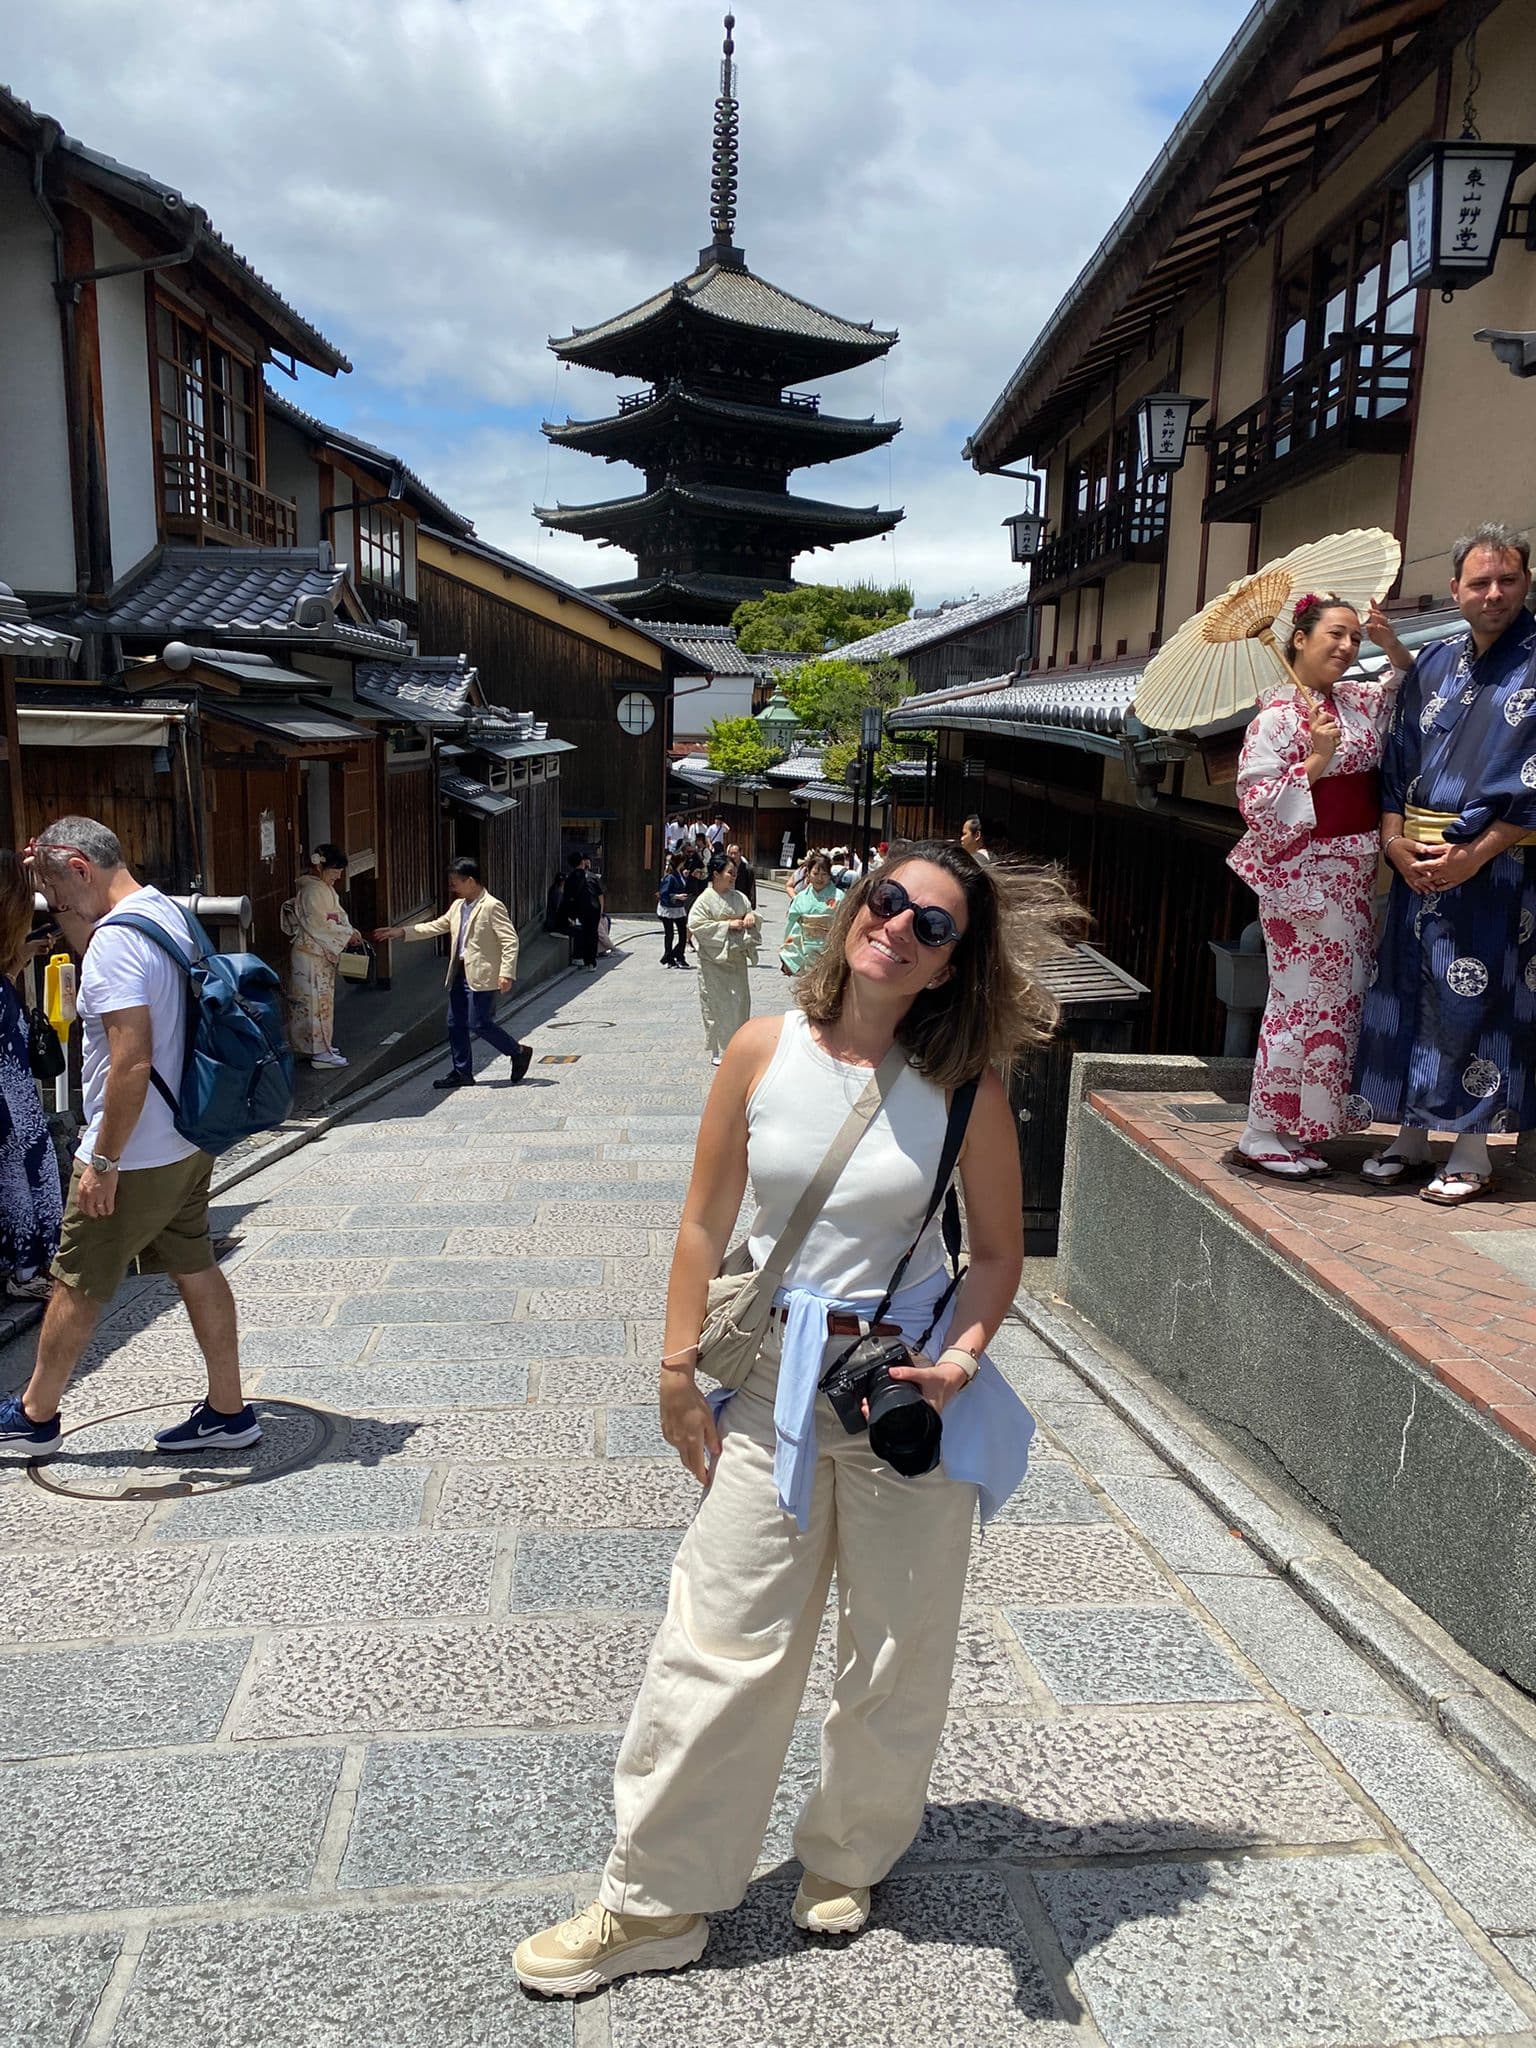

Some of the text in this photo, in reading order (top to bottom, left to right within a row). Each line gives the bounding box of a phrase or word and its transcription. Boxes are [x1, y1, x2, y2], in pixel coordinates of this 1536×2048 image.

[1452, 167, 1485, 251] 東山艸堂
[1159, 407, 1176, 454] 東山艸堂
